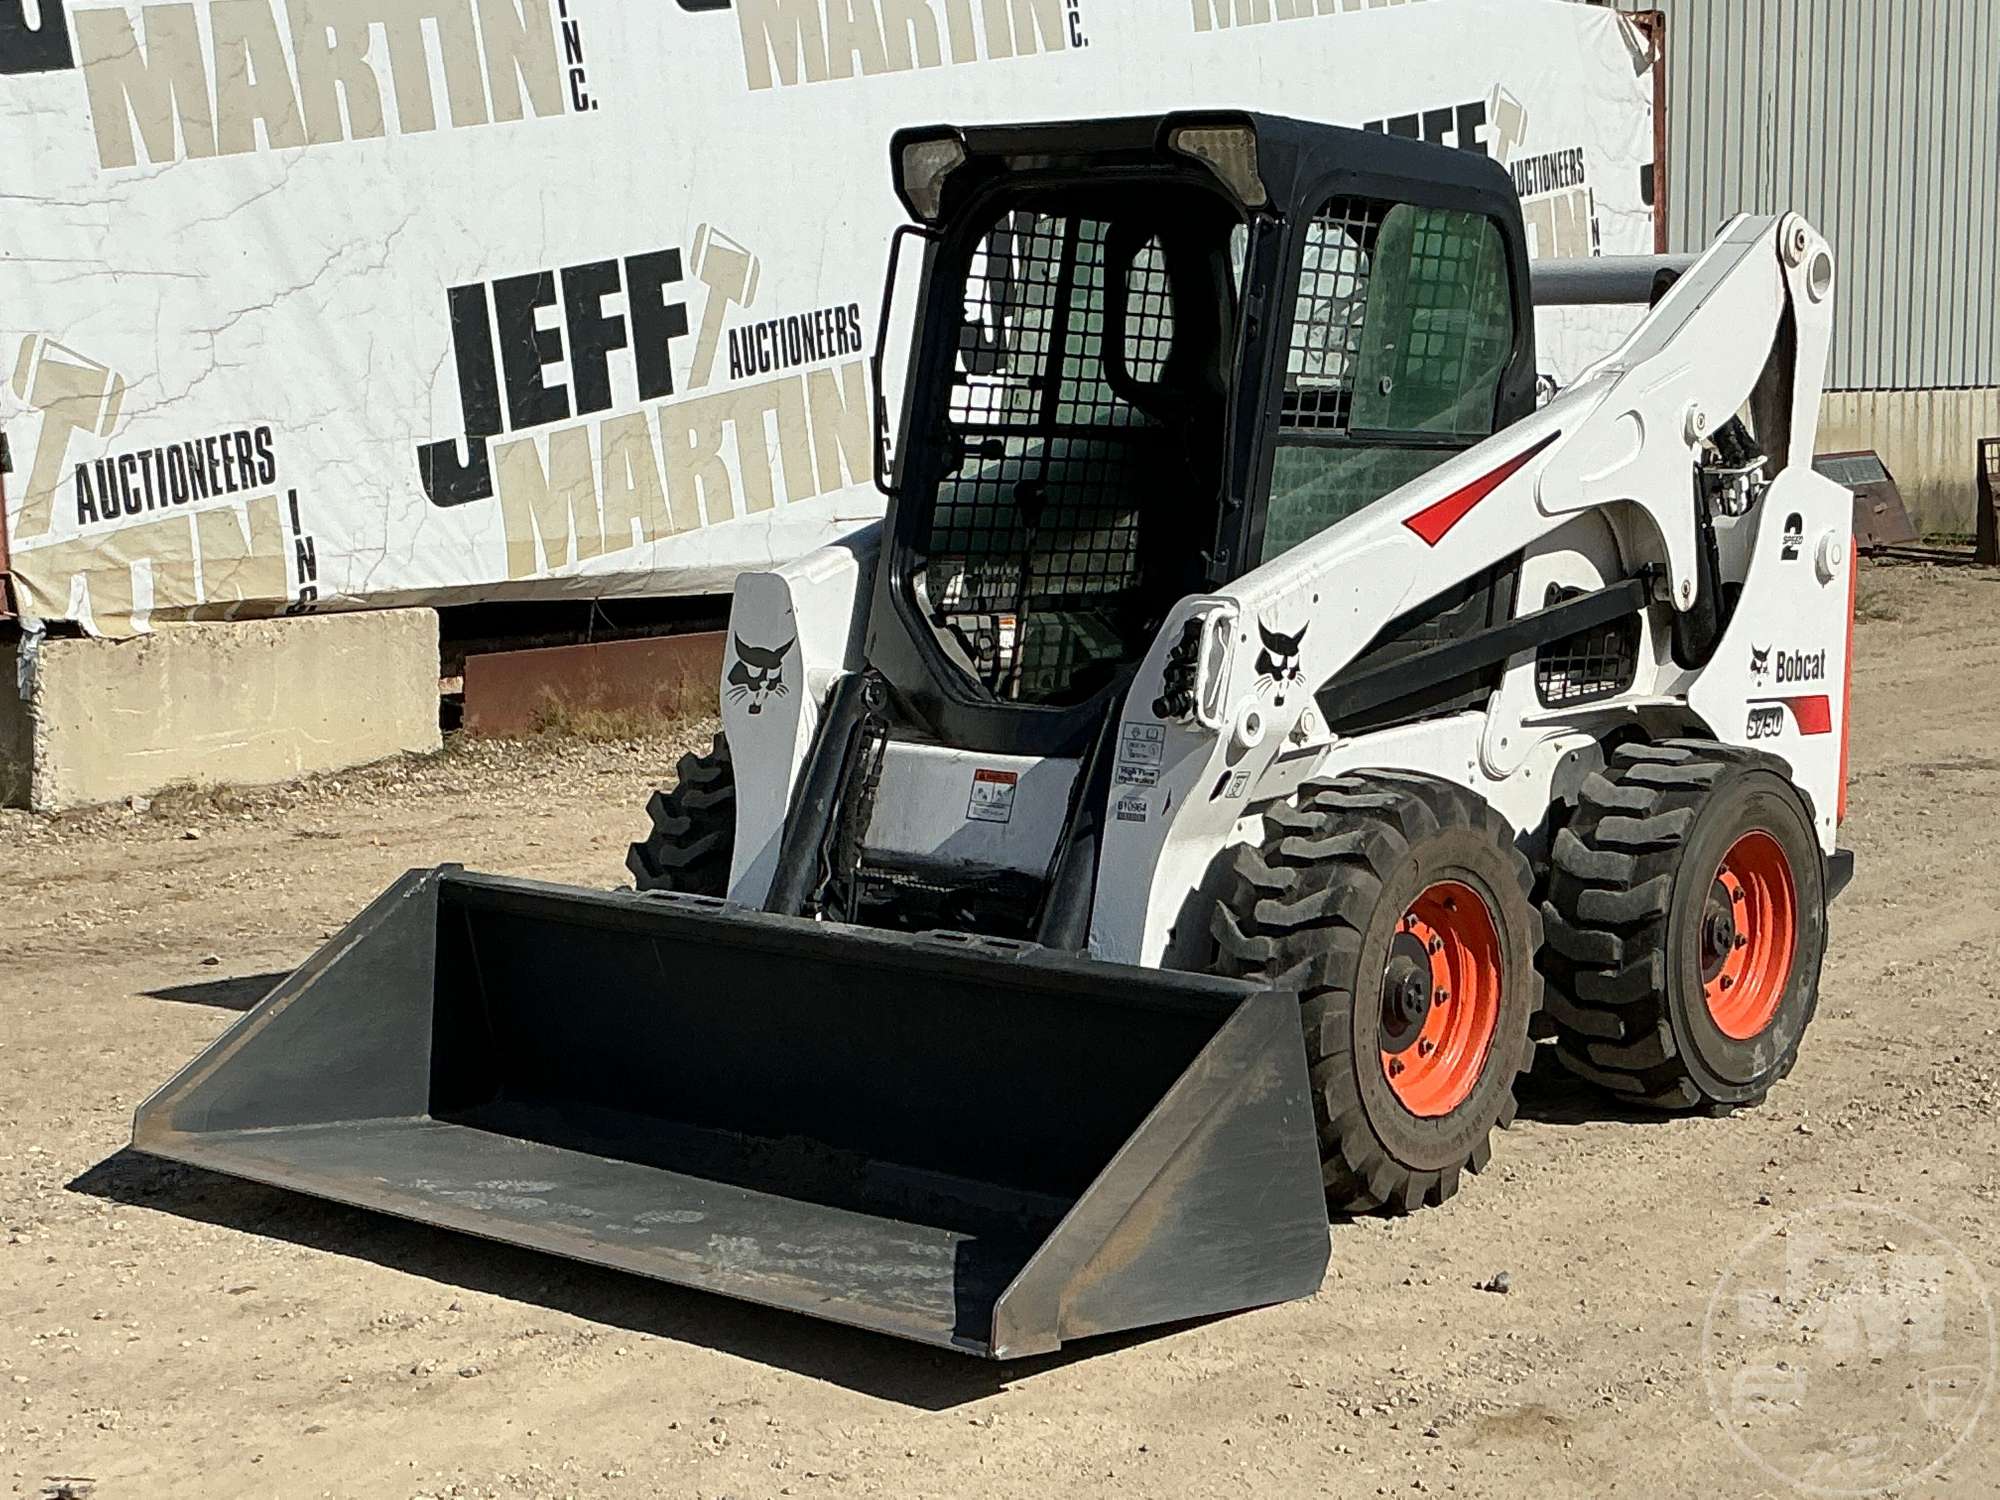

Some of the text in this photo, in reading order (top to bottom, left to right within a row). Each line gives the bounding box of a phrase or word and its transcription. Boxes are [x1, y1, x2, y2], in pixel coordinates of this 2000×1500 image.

[73, 0, 565, 169] MARTIN
[418, 247, 689, 508] JEFF
[728, 303, 862, 380] AUCTIONEERS
[74, 425, 276, 525] AUCTIONEERS
[494, 360, 873, 579] MARTIN
[1776, 648, 1826, 683] Bobcat
